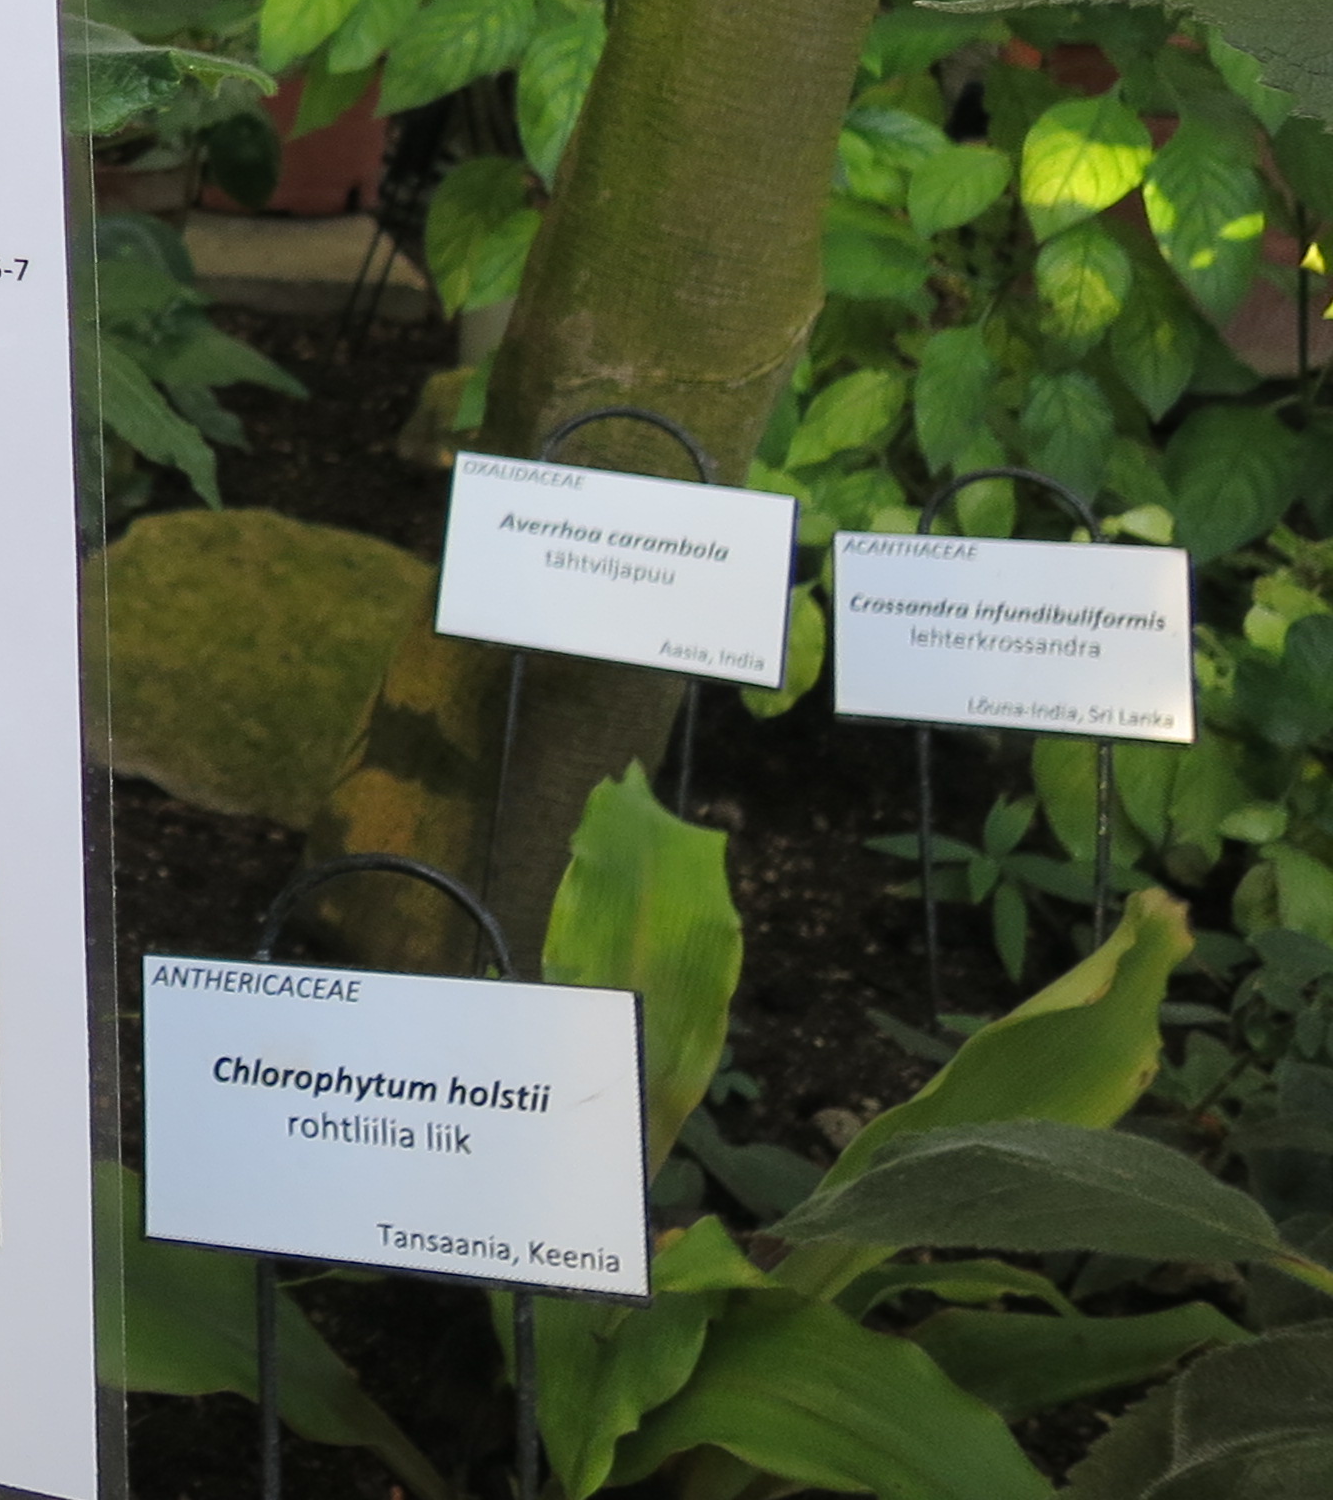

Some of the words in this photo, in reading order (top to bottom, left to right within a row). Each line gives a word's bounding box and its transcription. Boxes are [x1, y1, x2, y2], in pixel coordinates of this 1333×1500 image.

[462, 460, 586, 490] OXALIDACEAE
[499, 513, 603, 544] Averrhoa
[606, 531, 729, 562] carambola
[841, 538, 978, 560] ACANTHACEAE
[544, 550, 675, 585] tähtviljapuu
[849, 594, 969, 619] Crossandra
[974, 599, 1167, 632] infundibuliformis
[658, 640, 714, 665] Aasia,
[718, 648, 765, 672] India
[910, 625, 1101, 659] lehterkrossandra
[1118, 710, 1175, 730] Lanka
[151, 965, 362, 1003] ANTHERICACEAE
[212, 1056, 438, 1103] Chlorophytum
[447, 1076, 552, 1114] holstii
[288, 1113, 416, 1149] rohtliilia
[426, 1122, 472, 1156] liik
[376, 1223, 520, 1266] Tansaania,
[528, 1241, 621, 1273] Keenia
